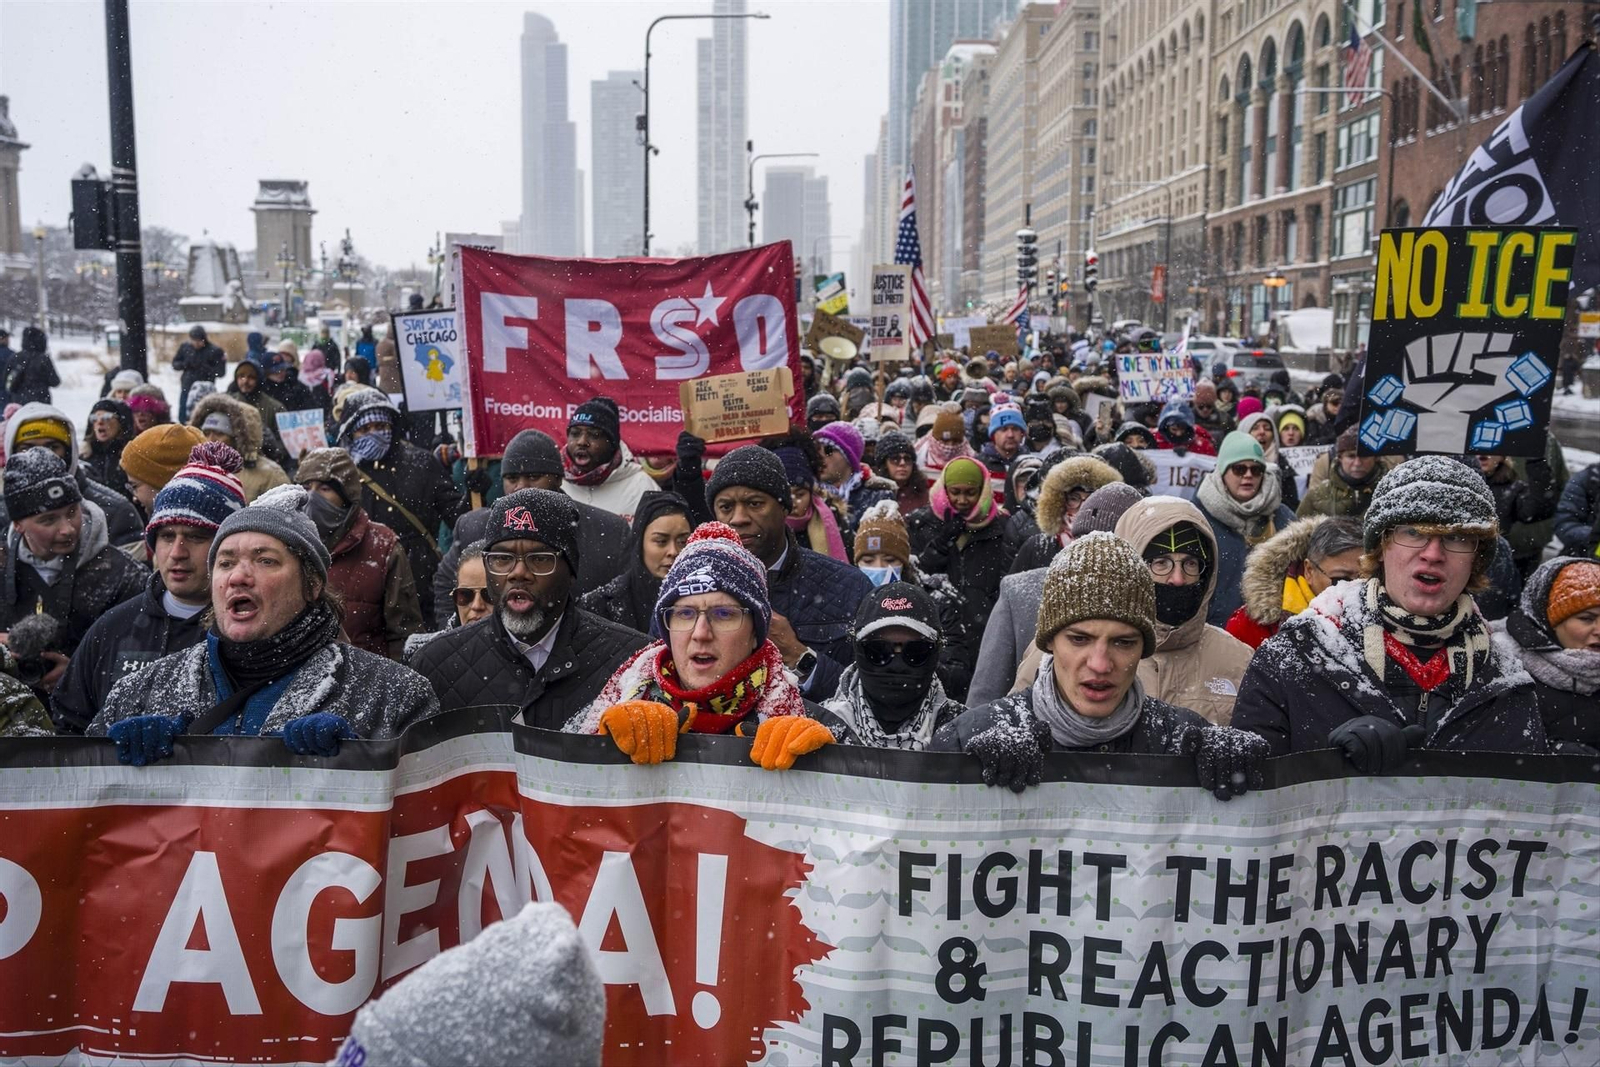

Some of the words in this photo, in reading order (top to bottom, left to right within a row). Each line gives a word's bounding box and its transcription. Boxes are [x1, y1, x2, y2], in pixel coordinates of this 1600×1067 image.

[874, 274, 905, 290] JUSTICE
[1374, 230, 1448, 320] NO
[1456, 231, 1578, 320] ICE
[403, 319, 425, 332] STAY
[428, 318, 454, 330] SALTY
[406, 330, 458, 345] CHICAGO
[480, 291, 789, 380] FRSO
[1117, 356, 1143, 372] LOVE
[1145, 356, 1163, 372] THY
[747, 377, 769, 386] RENEE
[1121, 380, 1151, 399] MATT
[696, 391, 719, 402] PRETTI
[723, 397, 744, 407] KEITH
[484, 397, 562, 419] Freedom
[748, 424, 761, 434] ICE
[503, 506, 539, 532] KA
[679, 581, 717, 596] SOX
[899, 849, 1127, 921] FIGHT
[1166, 853, 1294, 925] THE
[1314, 838, 1549, 911] RACIST
[935, 936, 988, 1004] &
[1028, 912, 1502, 1009] REACTIONARY
[1309, 983, 1589, 1067] AGENDA!
